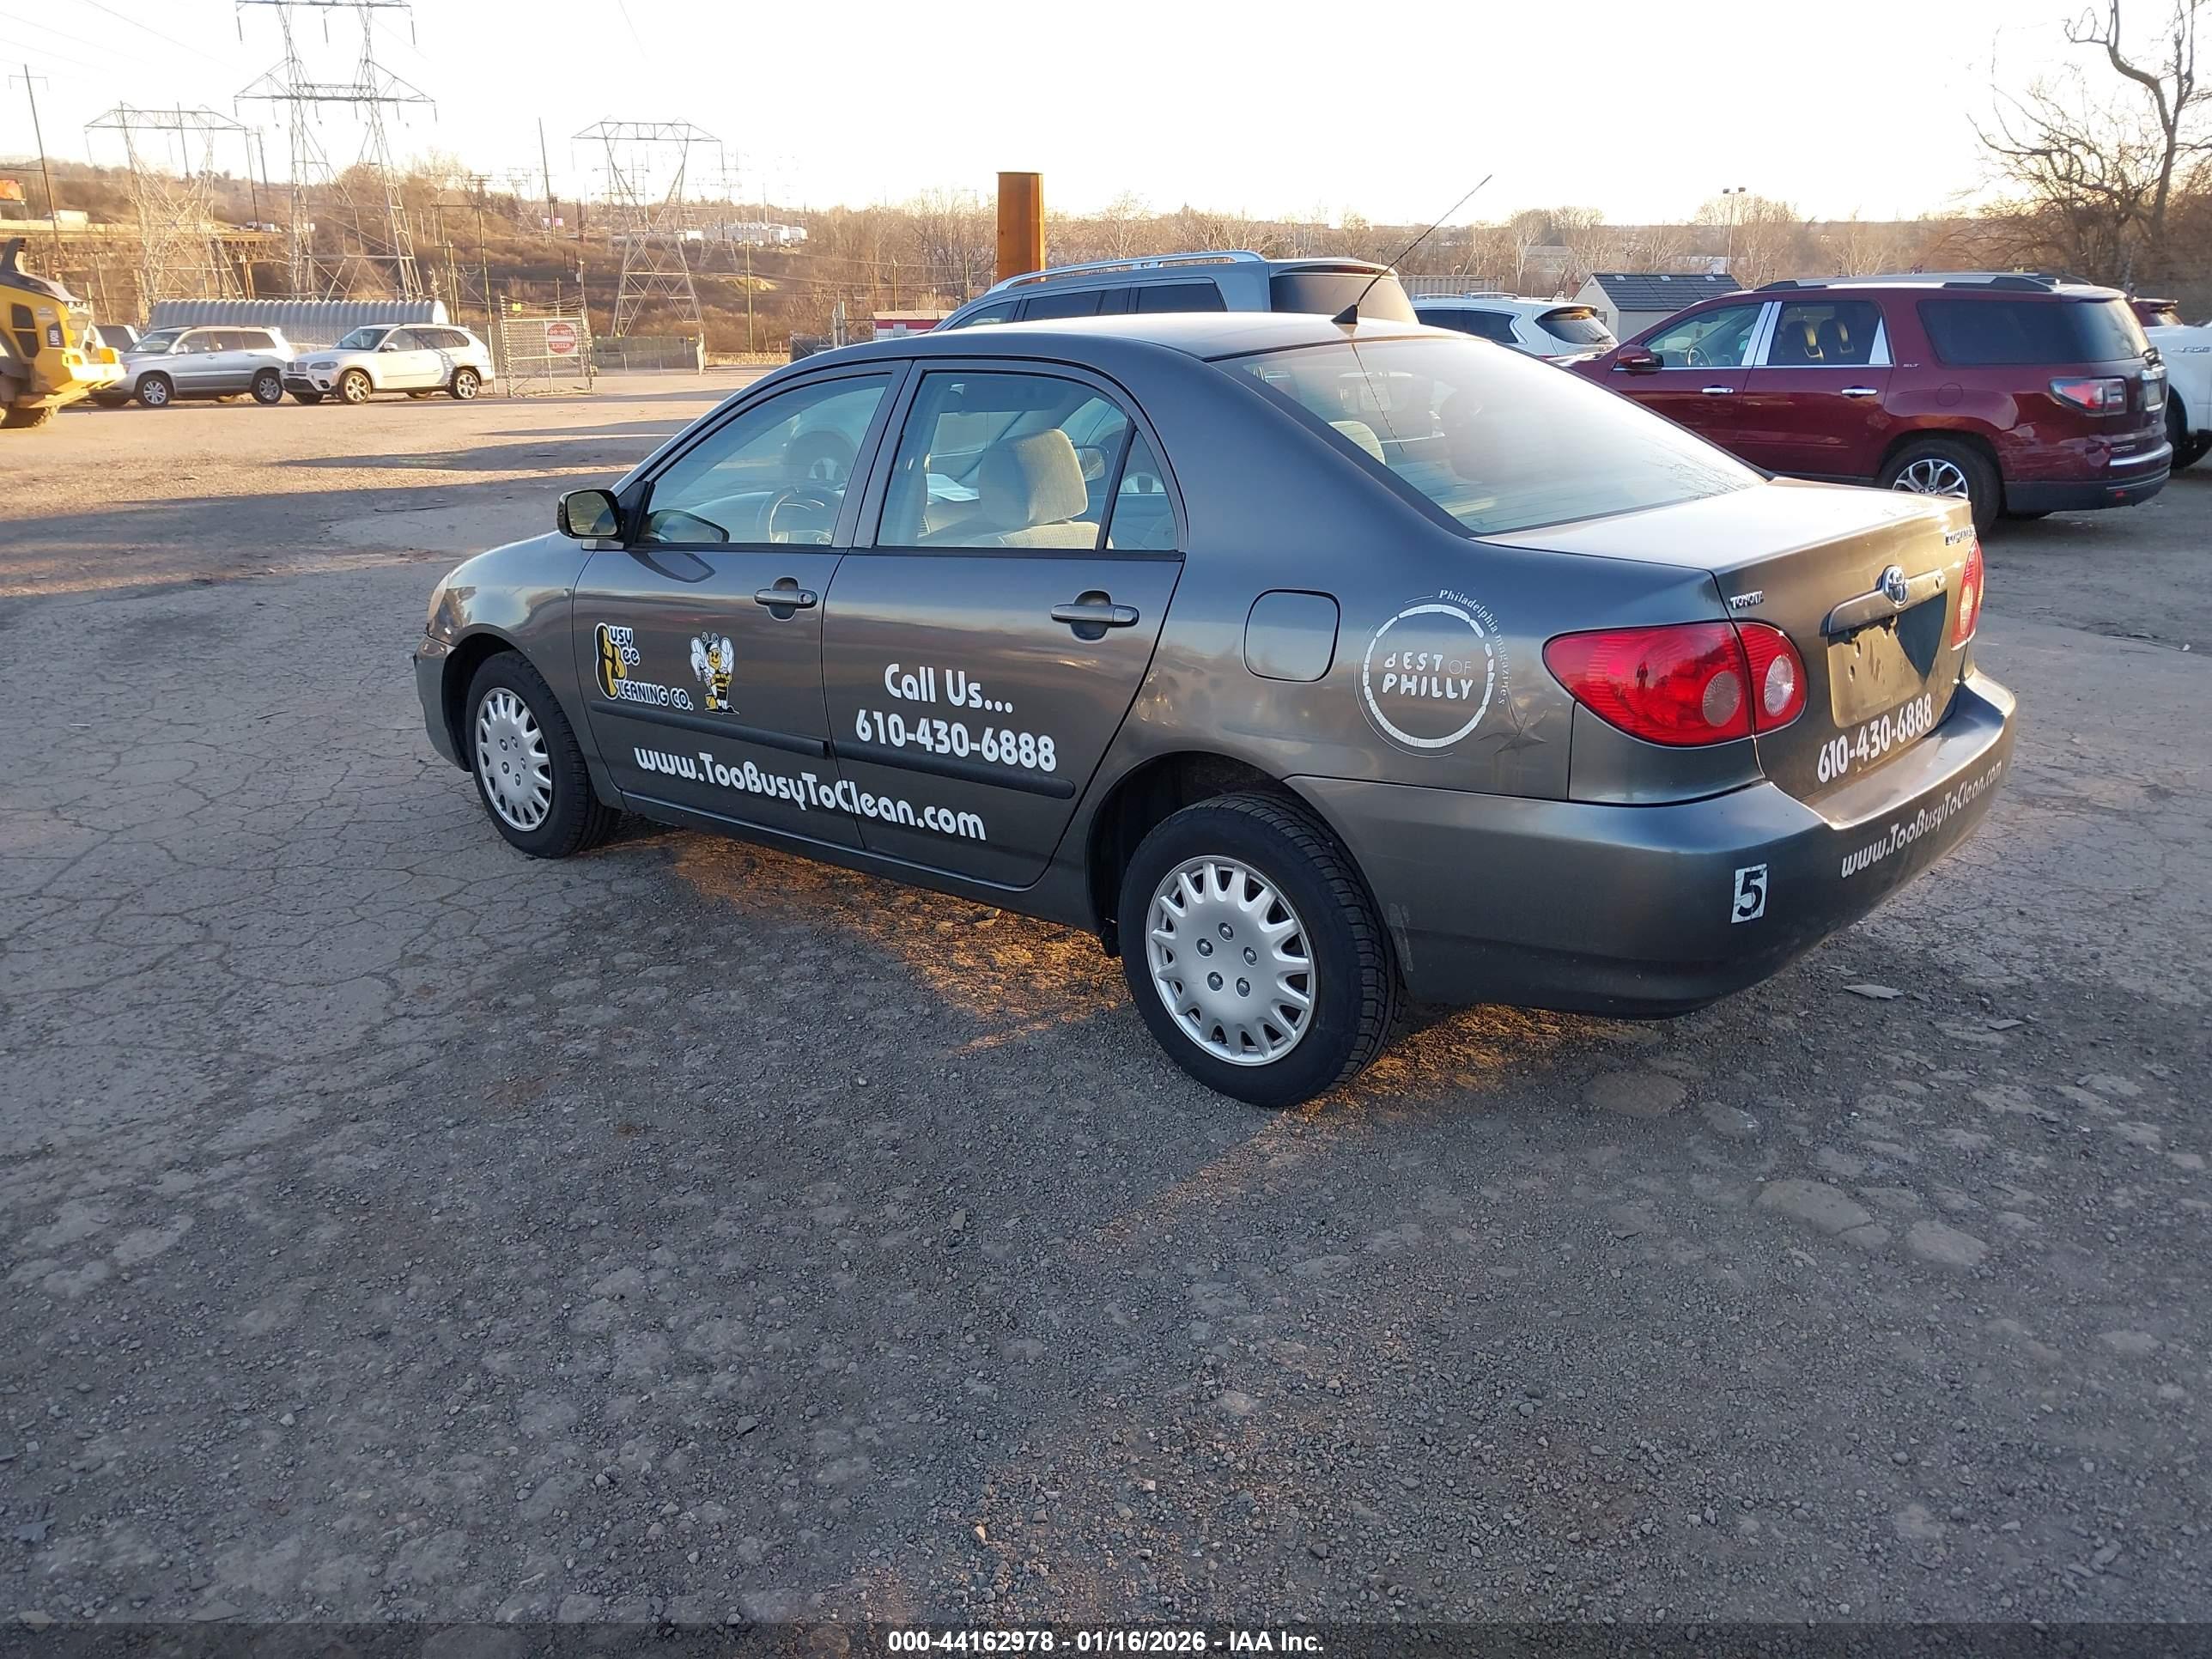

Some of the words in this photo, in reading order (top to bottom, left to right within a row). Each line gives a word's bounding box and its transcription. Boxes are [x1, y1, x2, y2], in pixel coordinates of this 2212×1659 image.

[1438, 589, 1498, 634] Philadelphia
[1729, 591, 1764, 610] TOYOTA
[884, 663, 936, 702] Call
[945, 670, 1013, 714] Us...
[1382, 672, 1474, 700] PHILLY
[1449, 659, 1473, 675] OF
[856, 709, 1056, 772] 610-430-6888
[1817, 692, 1932, 783] 610-430-6888
[634, 747, 987, 841] www.TooBusyToClean.com
[1840, 760, 2002, 878] www.TooBusyToClean.com
[1737, 869, 1763, 917] 5
